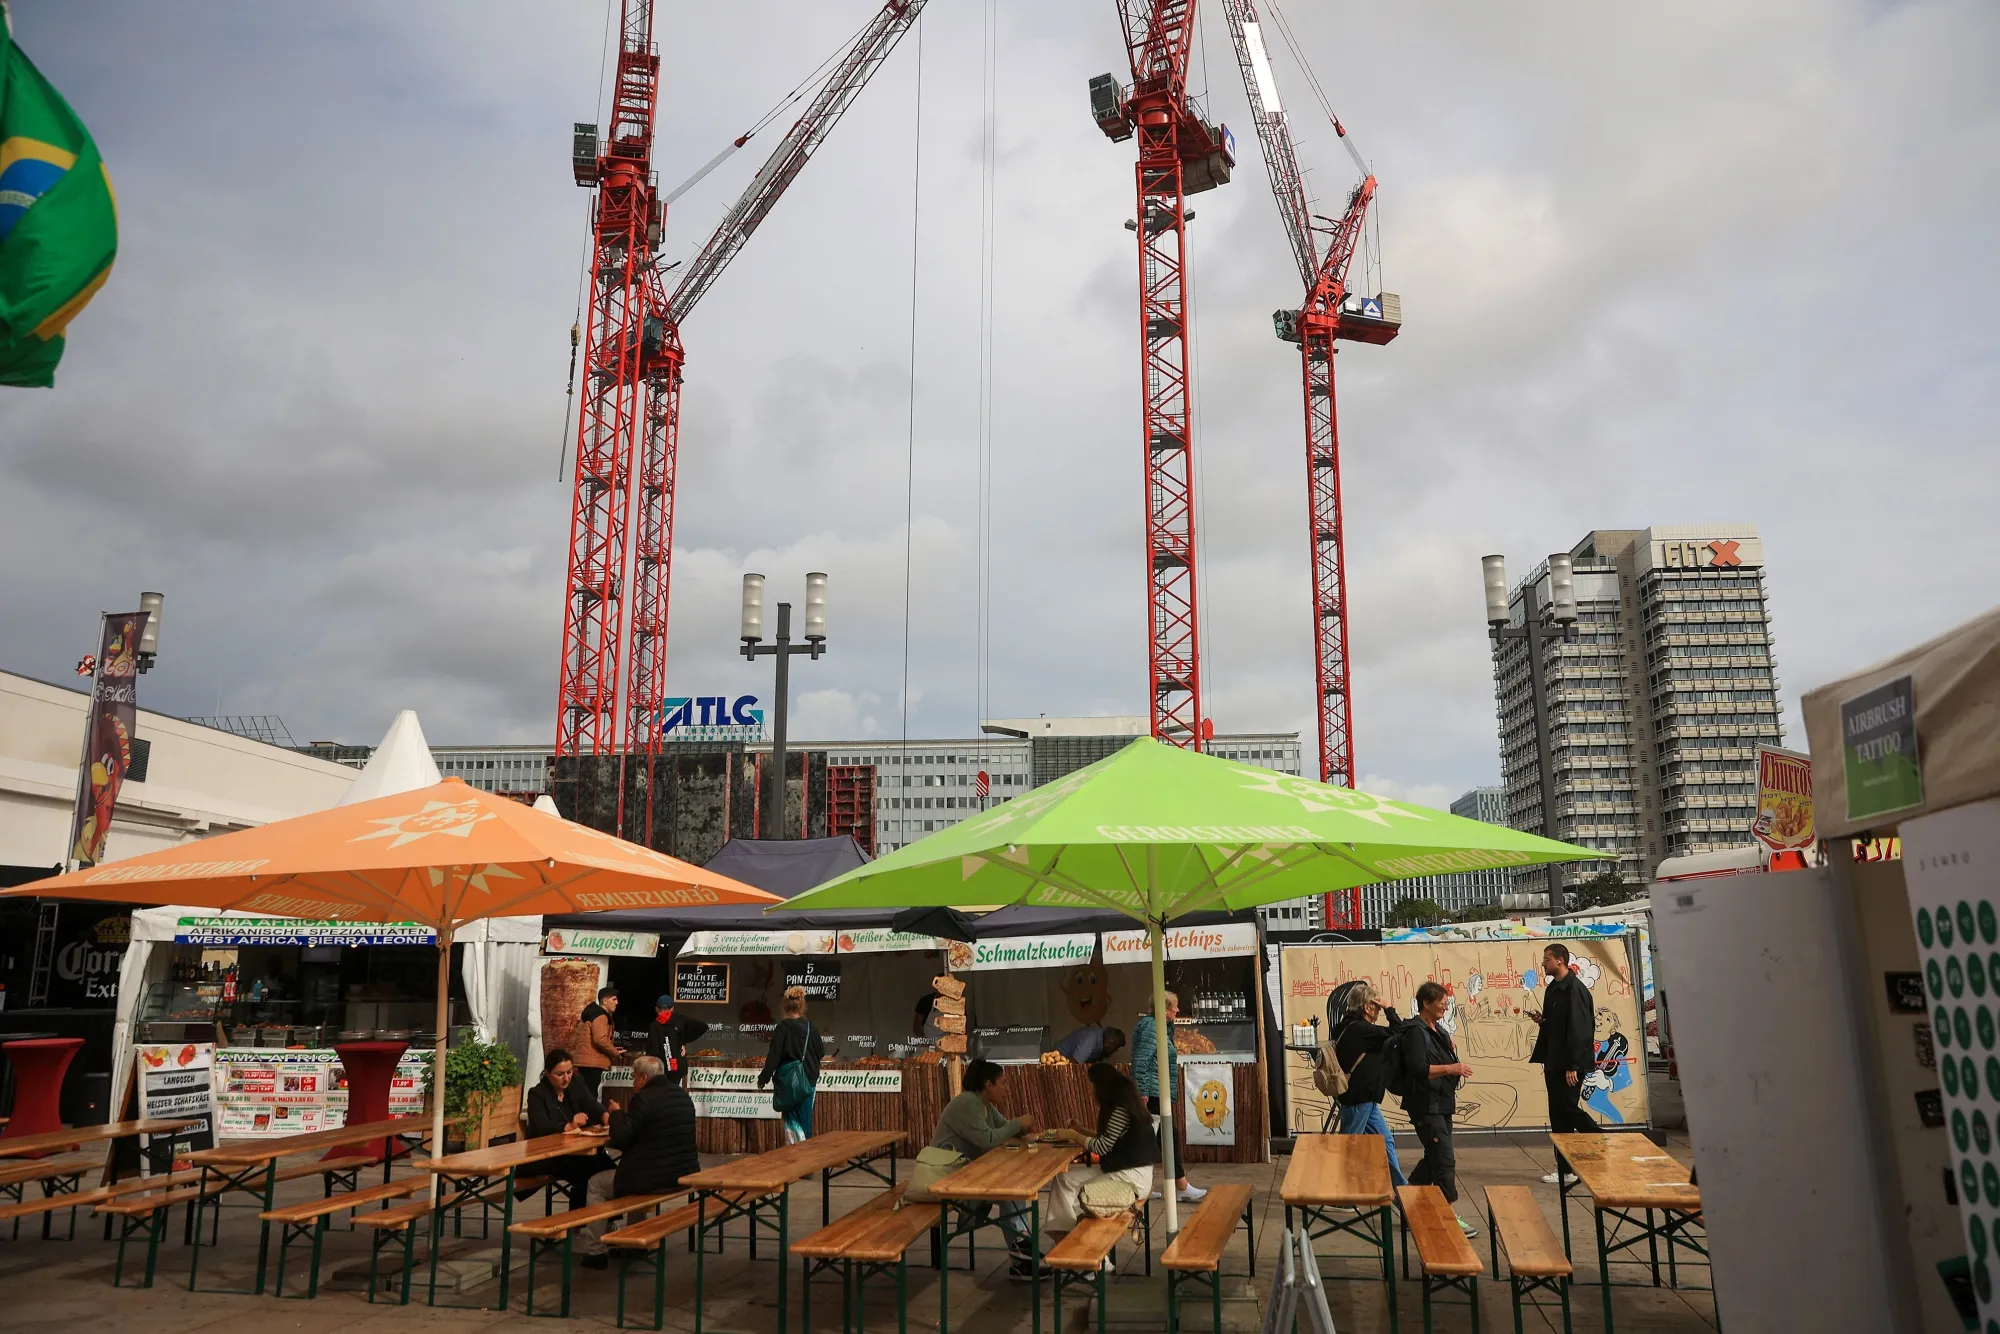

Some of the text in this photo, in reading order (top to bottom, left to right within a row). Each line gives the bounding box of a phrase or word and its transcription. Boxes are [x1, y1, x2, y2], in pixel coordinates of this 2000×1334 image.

[1847, 696, 1907, 737] AIRBRUSH
[1855, 731, 1902, 764] TATTOO
[1095, 825, 1325, 841] GEROLSTEINER
[85, 859, 271, 884] GEROLSTEINER
[193, 918, 252, 927] MAMA
[256, 918, 329, 927] AFRICA
[309, 927, 428, 935] SPEZIALITÄTEN
[187, 935, 428, 945] WEST AFRICA, SIERRA LEONE
[570, 931, 635, 953] Langosch
[713, 934, 720, 943] 5
[852, 932, 883, 943] Heißer
[975, 940, 1093, 963] Schmalzkuchen
[696, 965, 704, 974] 5
[806, 963, 815, 974] 5
[677, 973, 718, 981] GERICHTE
[786, 974, 804, 985] PAN
[85, 977, 119, 998] Ext
[217, 1053, 263, 1062] AMA
[163, 1075, 196, 1085] LANGOSCH
[690, 1069, 756, 1086] Reispfanne
[147, 1093, 210, 1109] HEISSER SCHAFSKÄSE
[737, 1094, 753, 1104] UND
[709, 1106, 759, 1115] SPEZIALITÄTEN
